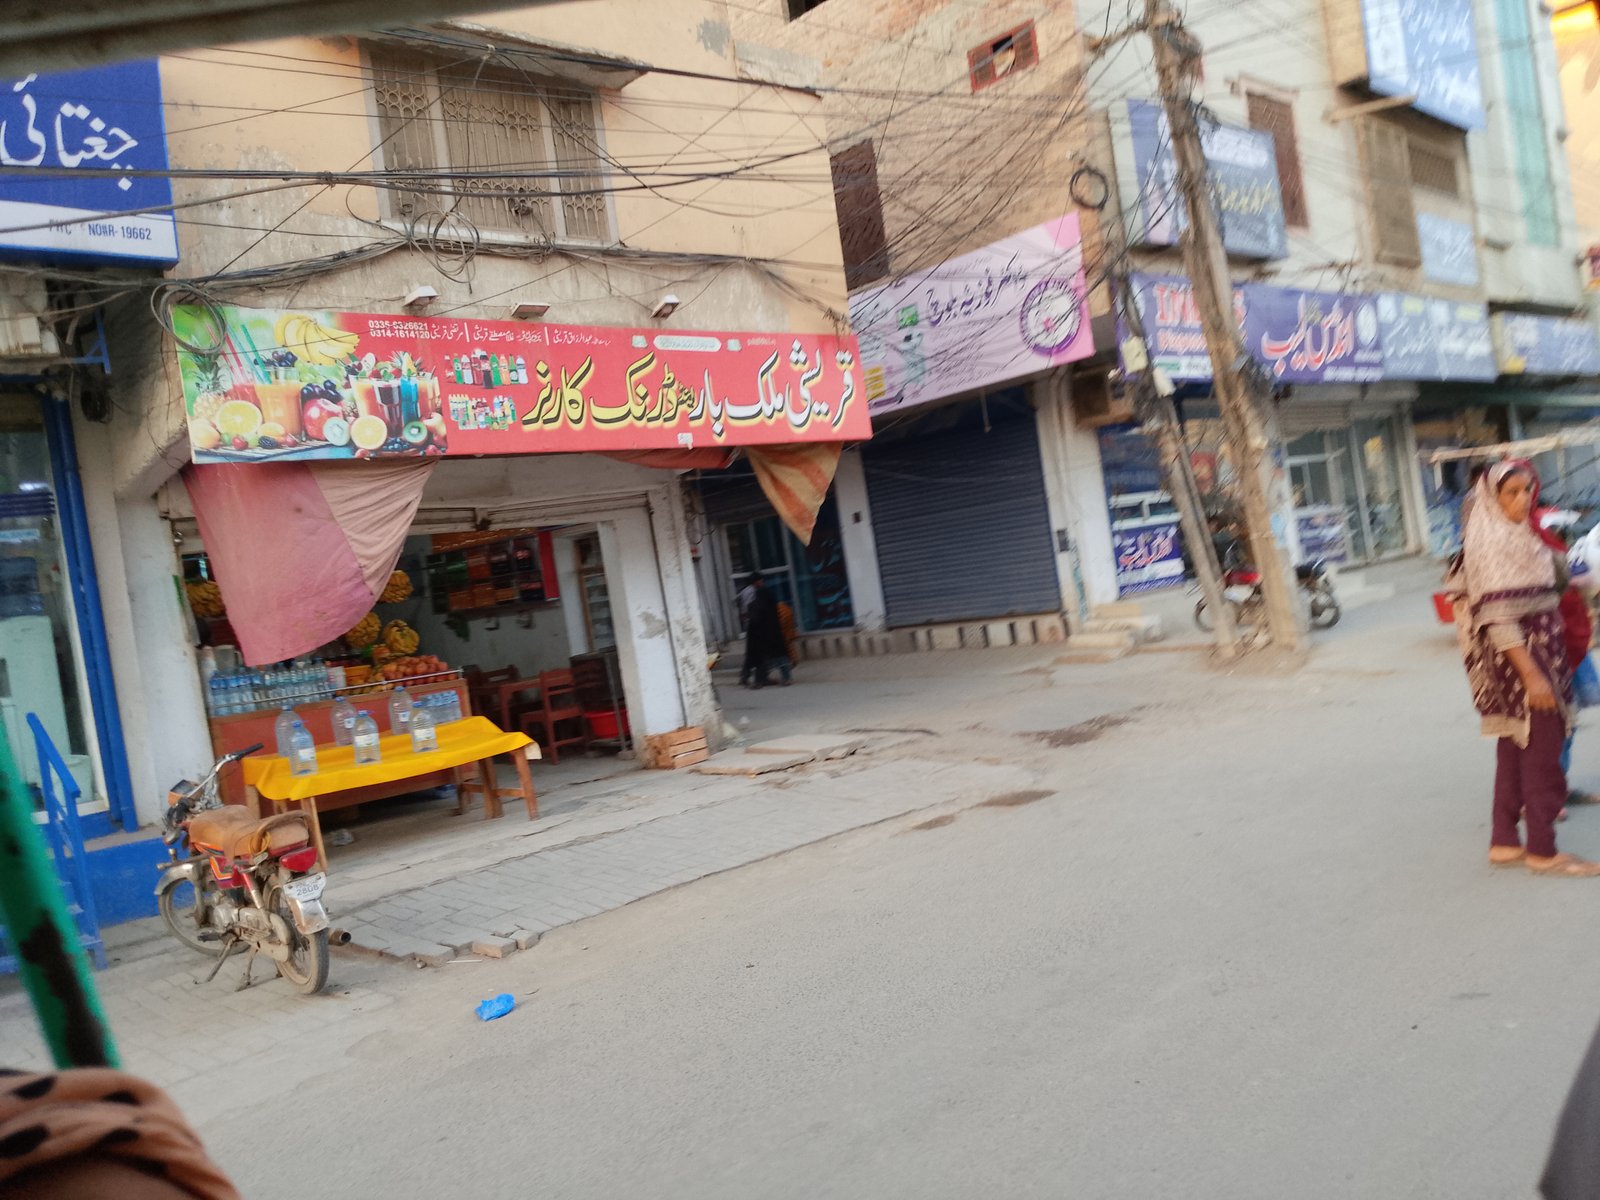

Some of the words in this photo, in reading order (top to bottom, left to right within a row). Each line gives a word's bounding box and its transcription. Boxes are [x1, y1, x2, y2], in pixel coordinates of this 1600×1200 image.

[590, 351, 678, 424] ڈرنک
[688, 368, 723, 437] بار
[725, 350, 784, 421] ملک
[785, 338, 857, 428] قریشی
